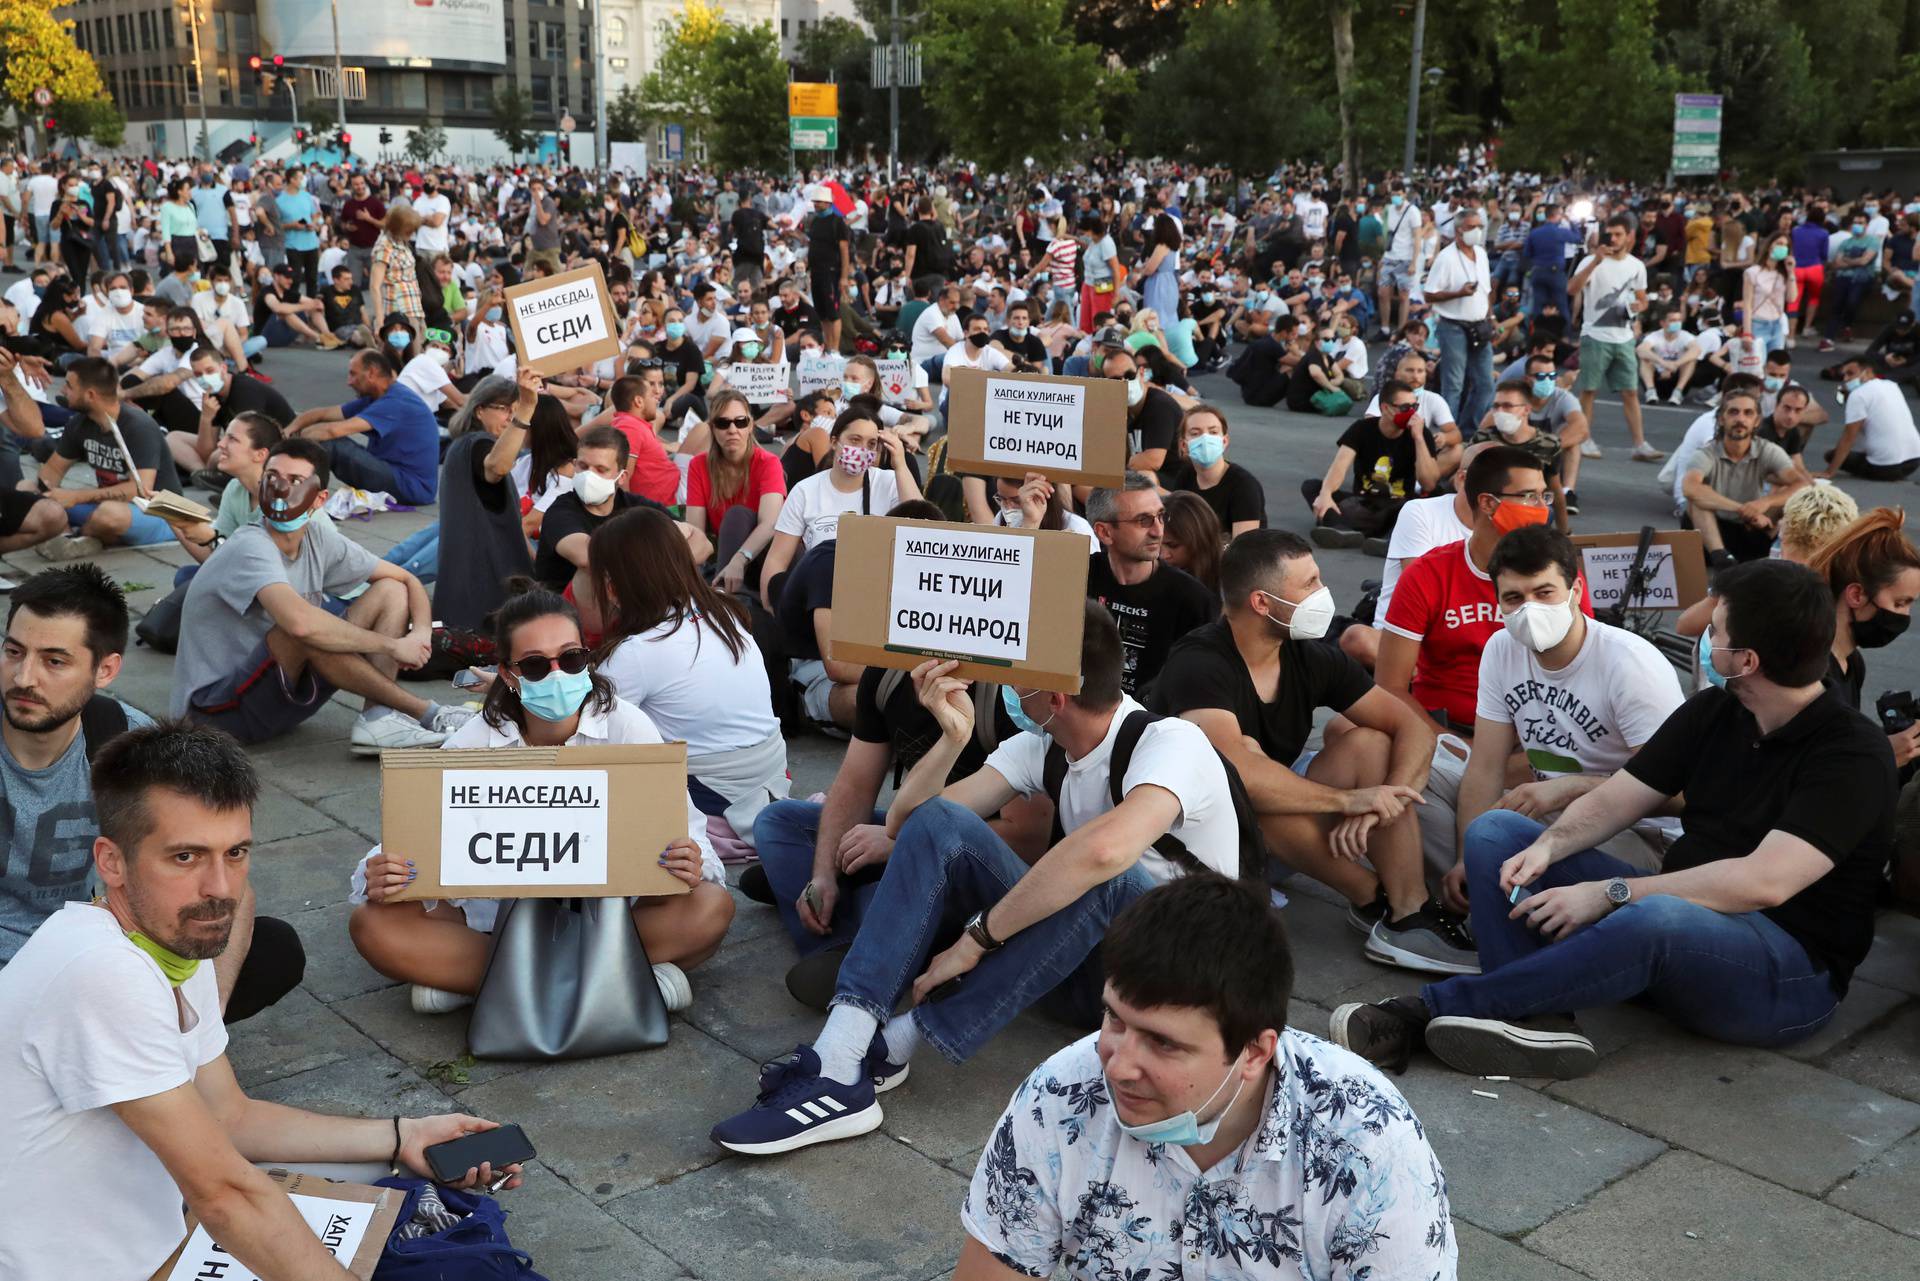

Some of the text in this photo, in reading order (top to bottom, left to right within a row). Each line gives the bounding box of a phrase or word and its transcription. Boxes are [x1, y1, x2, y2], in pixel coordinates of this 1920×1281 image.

[520, 287, 594, 316] НЕ НАСЕДАЈ,
[536, 314, 592, 345] СЕДИ
[994, 388, 1076, 404] ХАПСИ ХУЛИГАНЕ
[1004, 410, 1063, 430] НЕ ТУЦИ
[989, 436, 1077, 460] СВОЈ НАРОД
[906, 540, 1021, 563] ХАПСИ ХУЛИГАНЕ
[918, 571, 1003, 602] НЕ ТУЦИ
[1603, 568, 1620, 579] НЕ
[896, 609, 1021, 647] СВОЈ НАРОД
[1523, 718, 1578, 752] Fitch
[451, 786, 600, 807] НЕ НАСЕДАЈ,
[468, 832, 579, 872] СЕДИ
